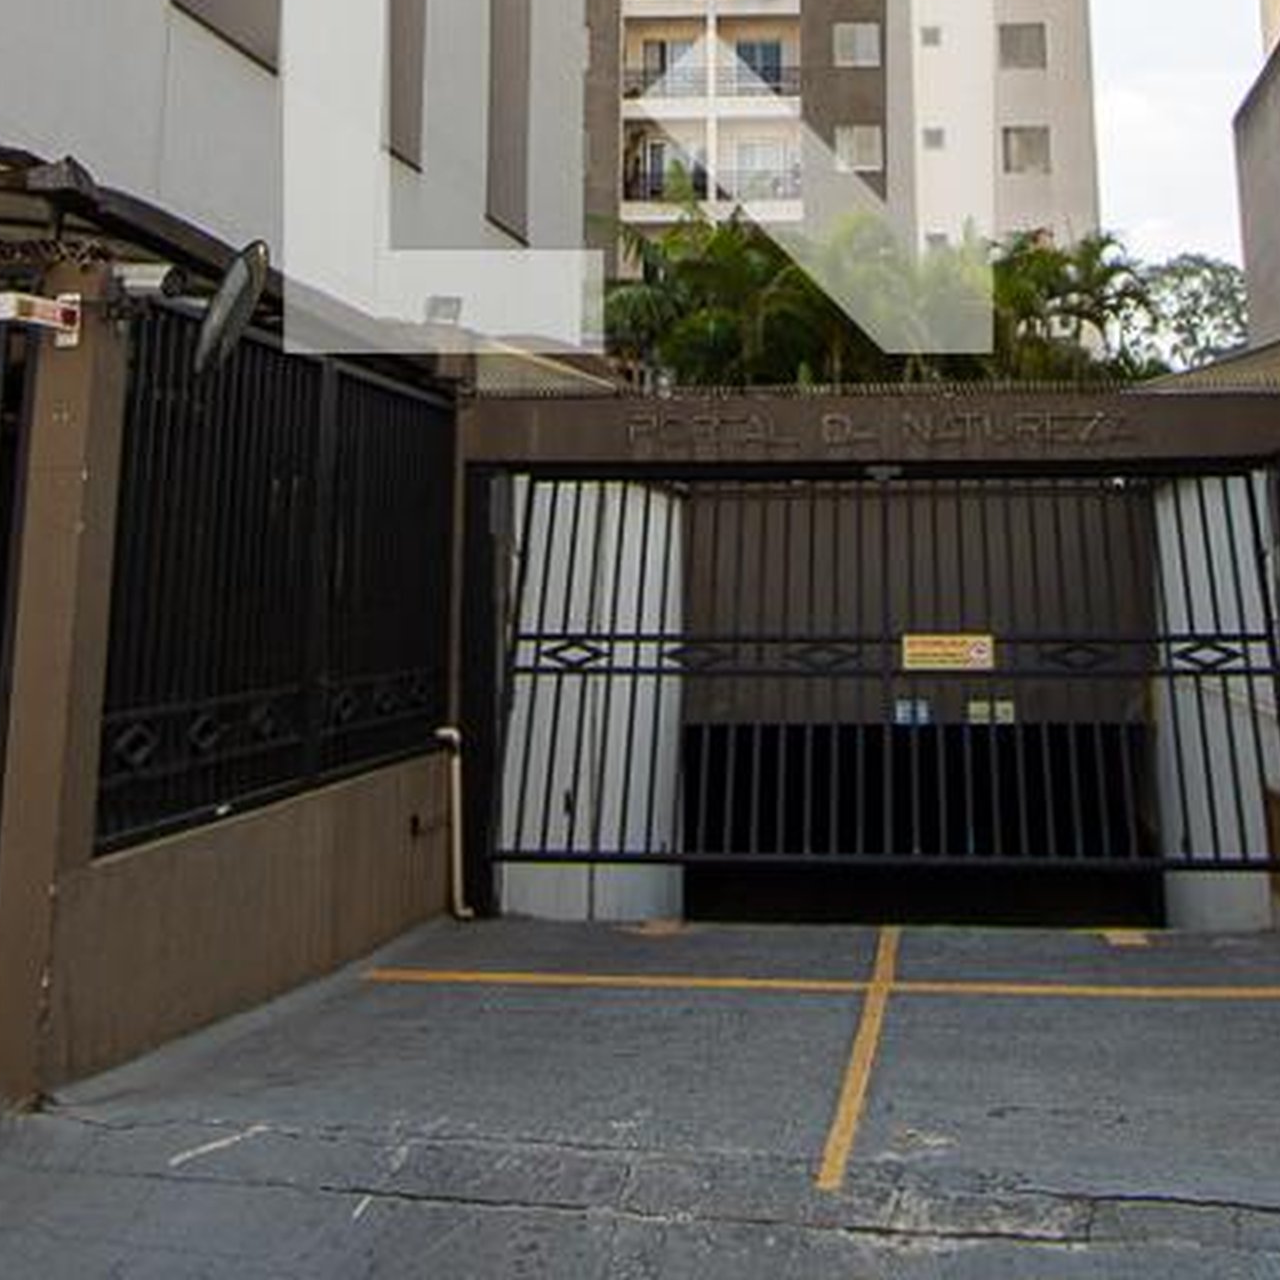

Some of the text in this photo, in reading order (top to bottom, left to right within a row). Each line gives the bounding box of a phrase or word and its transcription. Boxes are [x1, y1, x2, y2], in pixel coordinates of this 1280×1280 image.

[627, 411, 1135, 446] PORTAL DA NATUREZA
